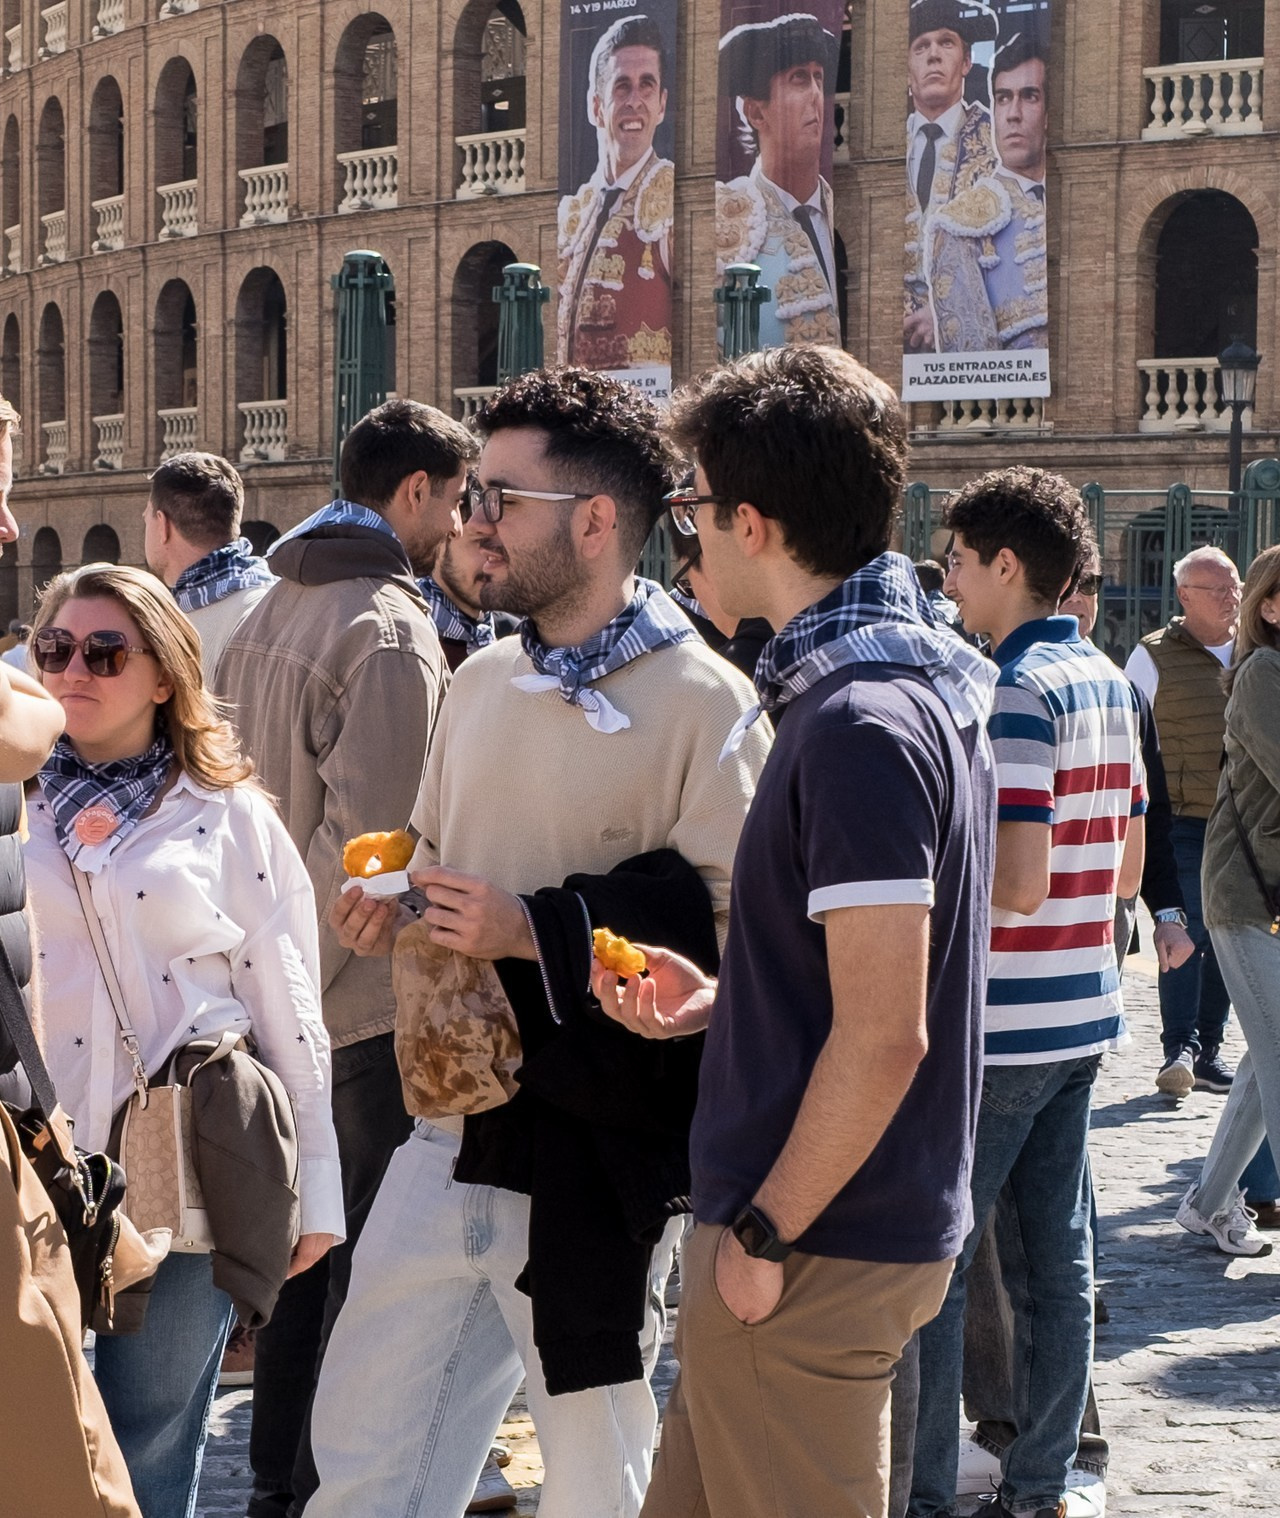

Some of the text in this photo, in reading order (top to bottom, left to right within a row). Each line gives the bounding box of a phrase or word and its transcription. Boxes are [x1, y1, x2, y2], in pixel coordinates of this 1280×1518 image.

[570, 5, 581, 14] 14
[602, 0, 637, 10] MARZO
[924, 359, 1032, 372] TUS ENTRADAS EN
[645, 377, 656, 387] EN
[909, 372, 1047, 386] PLAZADEVALENCIA.ES
